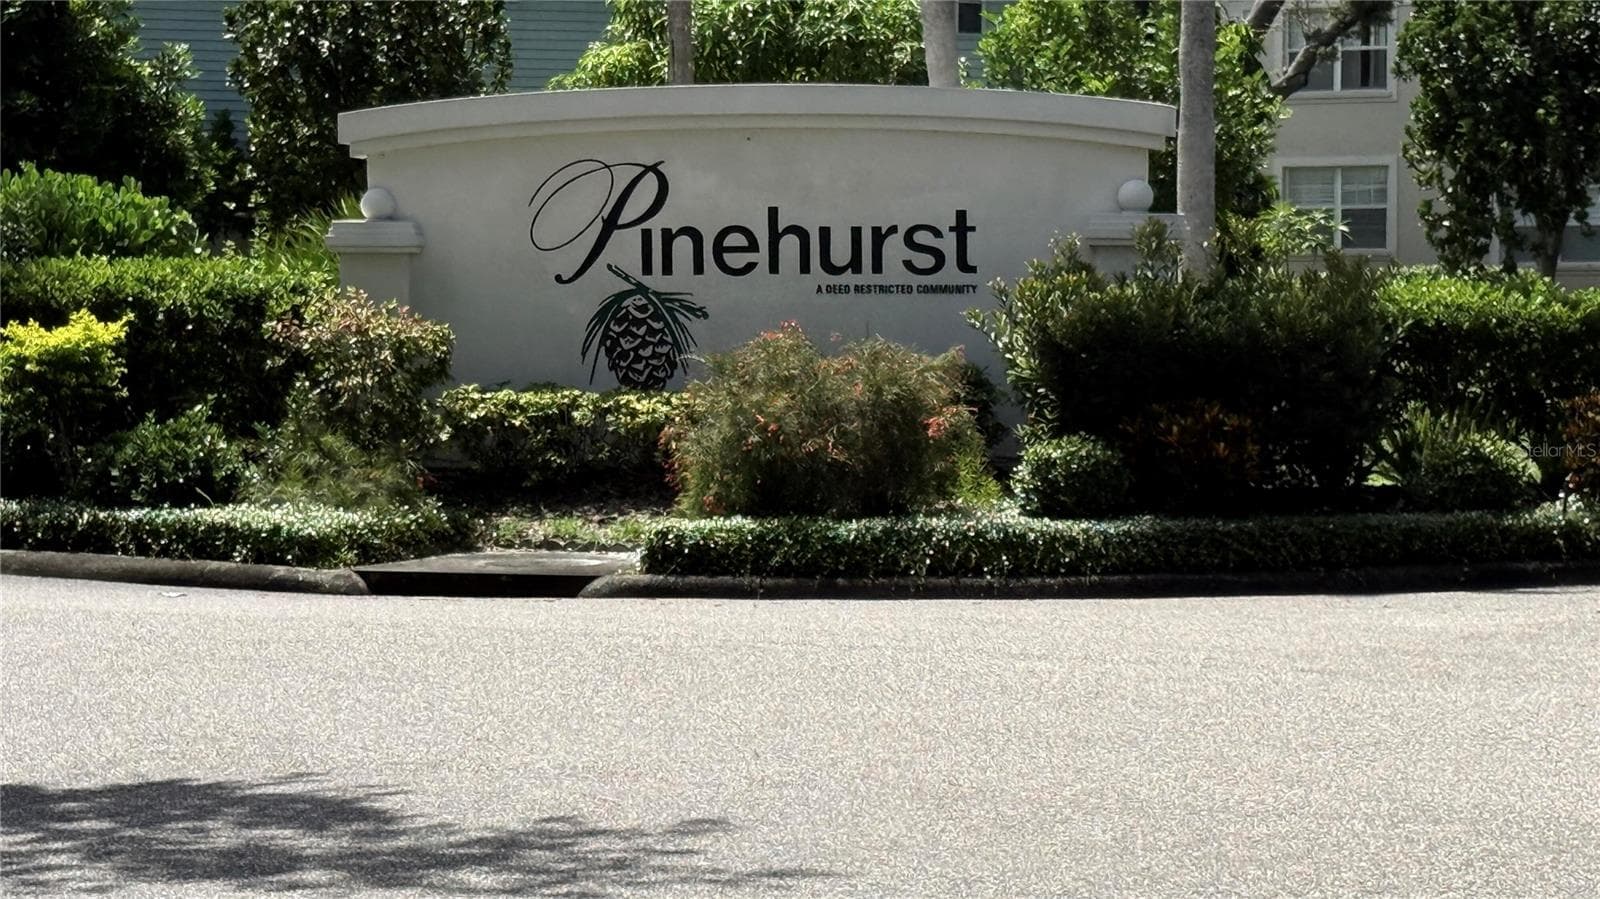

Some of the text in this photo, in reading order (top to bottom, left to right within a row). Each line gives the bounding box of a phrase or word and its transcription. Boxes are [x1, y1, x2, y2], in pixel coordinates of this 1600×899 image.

[528, 158, 978, 285] Pinehurst
[815, 284, 979, 295] A DEED RESTRICTED COMMUNITY
